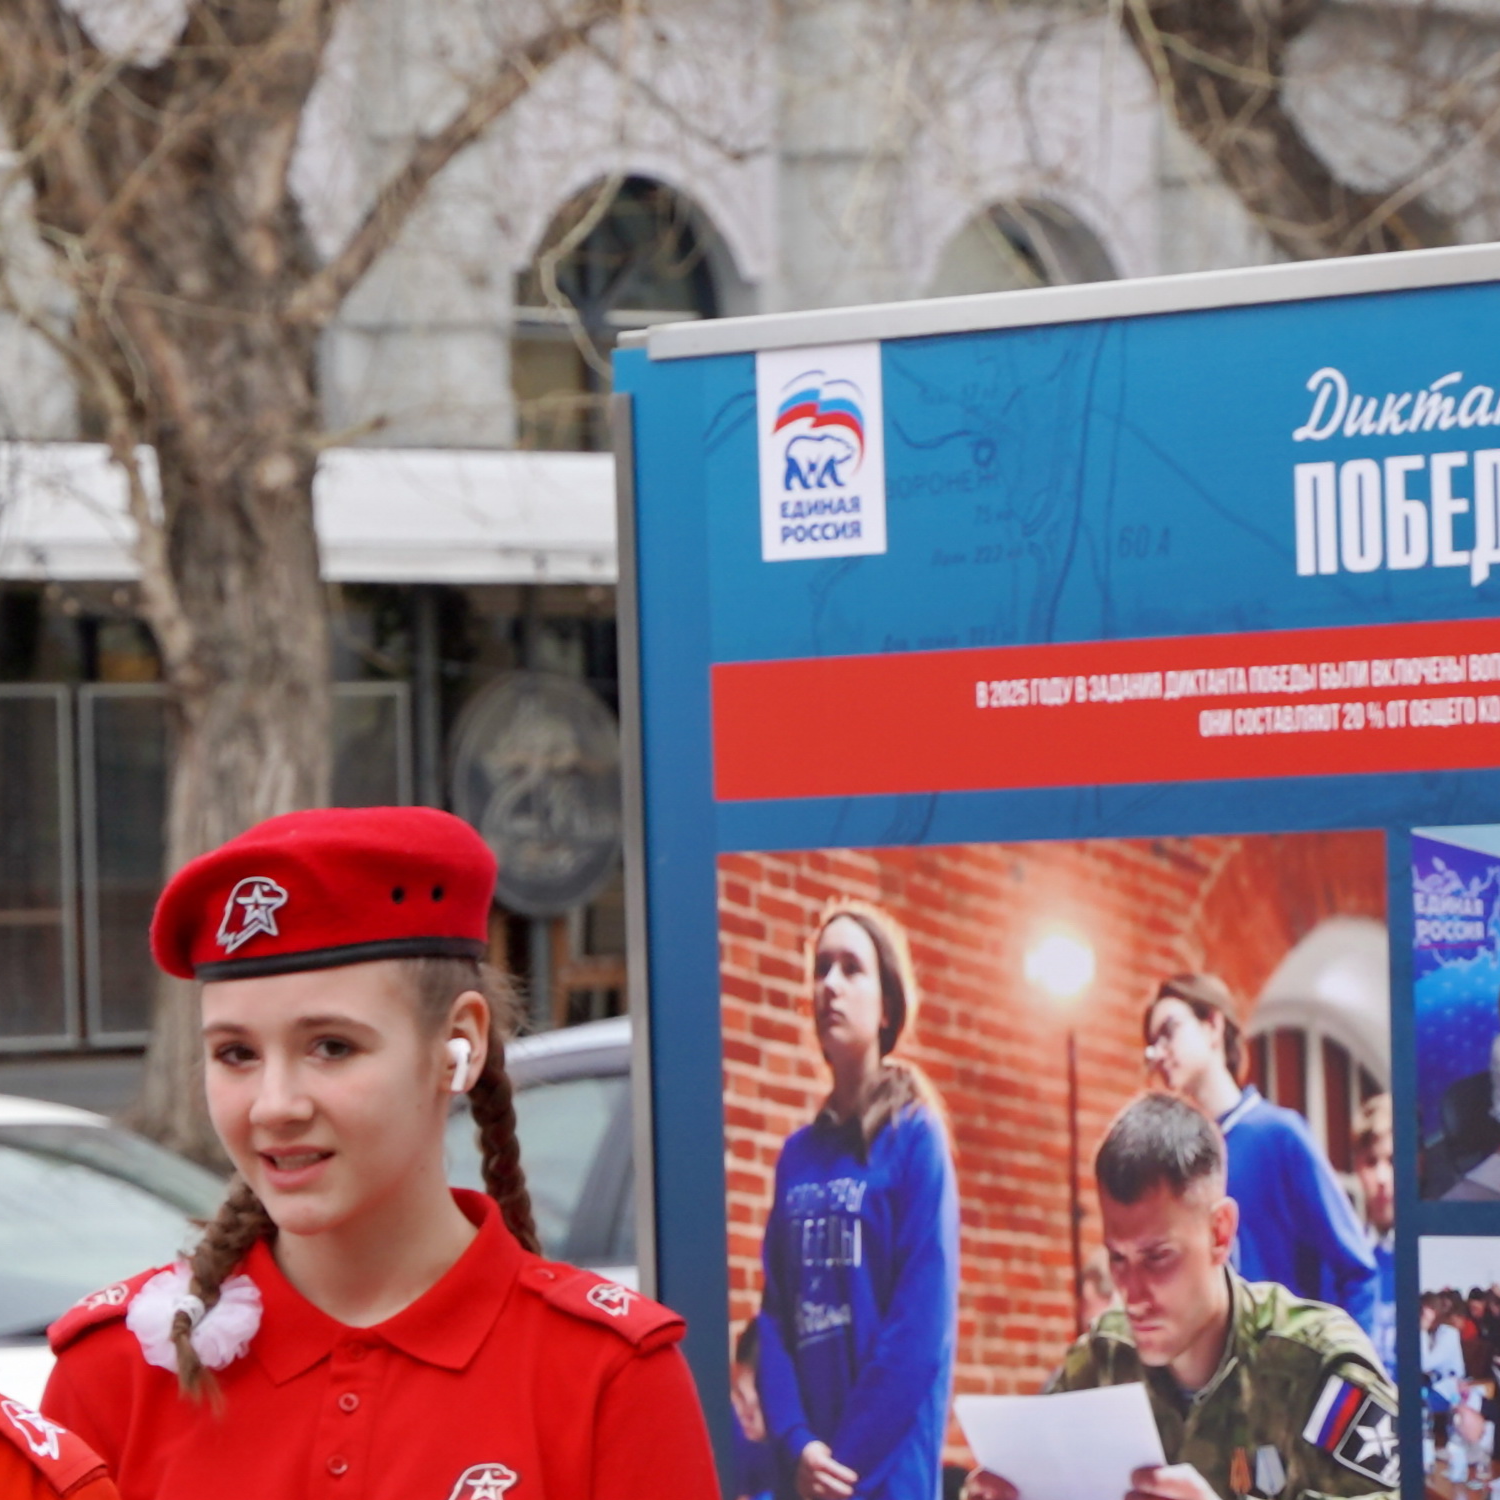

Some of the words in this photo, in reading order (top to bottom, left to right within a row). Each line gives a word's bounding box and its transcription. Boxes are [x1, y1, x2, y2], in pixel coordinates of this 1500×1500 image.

[781, 496, 861, 520] ЕДИНАЯ
[781, 519, 862, 544] РОССИЯ
[976, 681, 989, 708] В
[990, 679, 1029, 707] 2025
[1031, 676, 1074, 706] ГОДУ
[1075, 676, 1087, 703] В
[1088, 671, 1163, 703] ЗАДАНИЯ
[1164, 667, 1247, 700] ДИКТАНТА
[1249, 663, 1317, 693] ПОБЕДЫ
[1319, 660, 1368, 689] БЫЛИ
[1371, 655, 1466, 687] ВКЛЮЧЕНЫ
[1199, 709, 1233, 737] ОНИ
[1234, 703, 1340, 735] СОСТАВЛЯЮТ
[1342, 702, 1365, 730] 20
[1366, 701, 1385, 729] %
[1386, 700, 1407, 728] ОТ
[1409, 696, 1476, 728] ОБЩЕГО
[1413, 891, 1484, 916] ЕДИНАЯ
[1415, 919, 1485, 944] РОССИЯ
